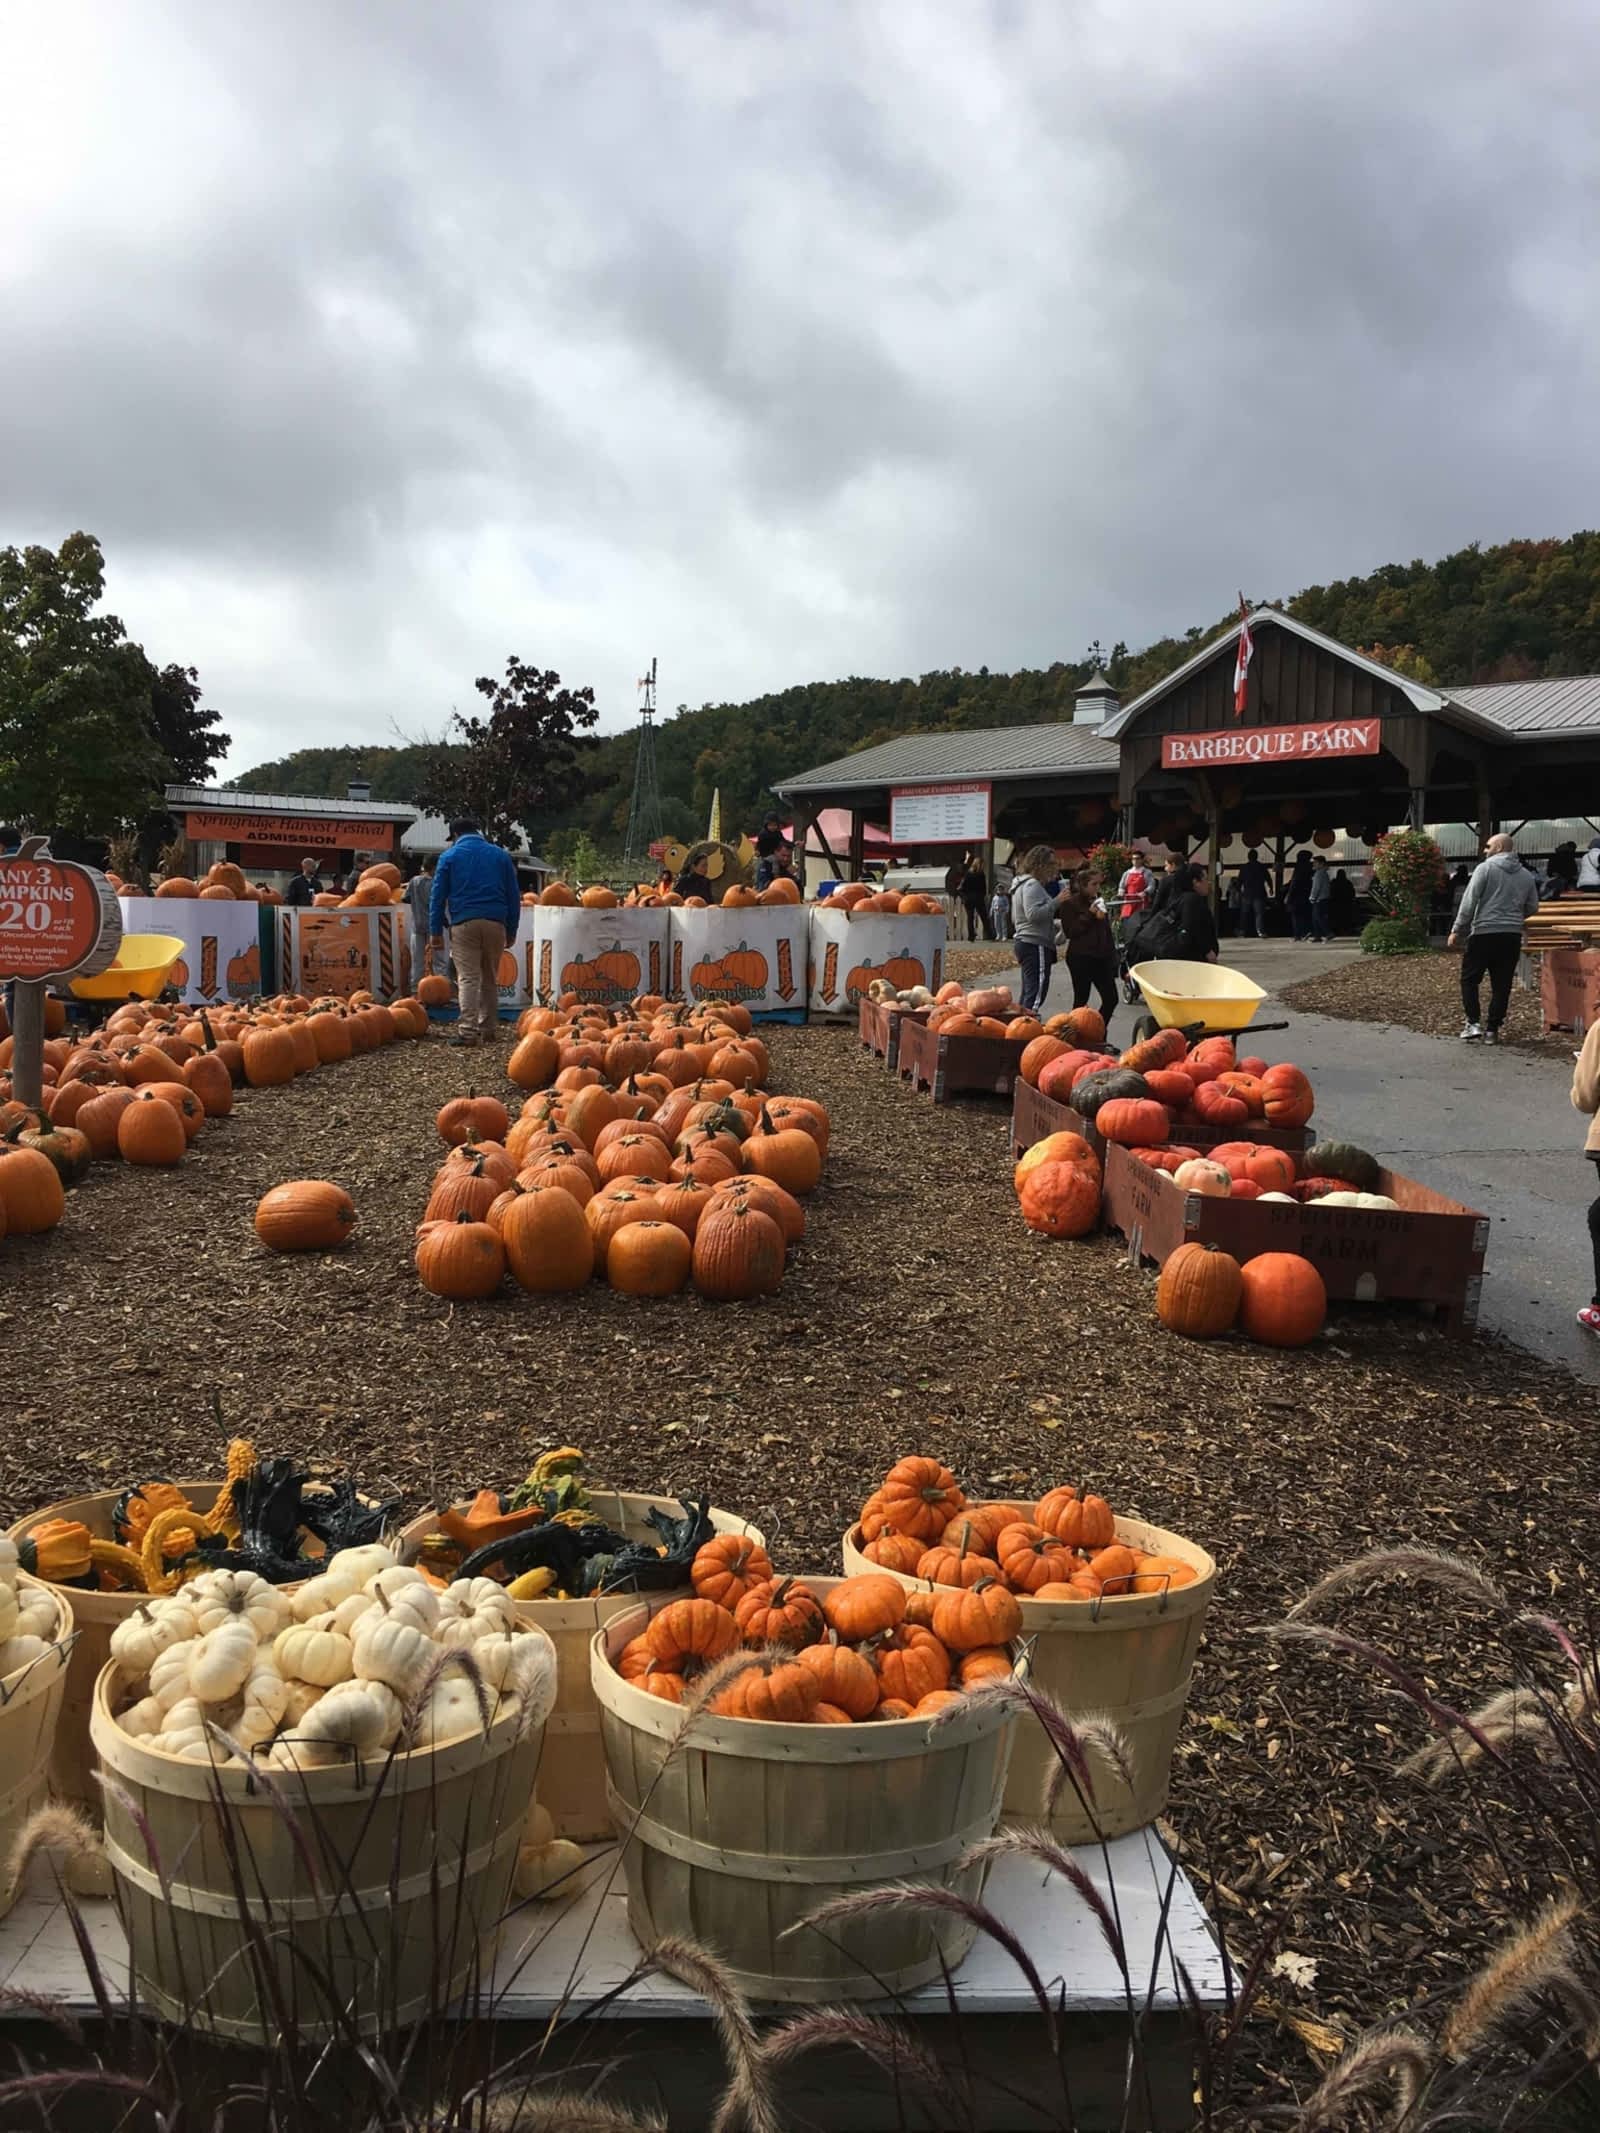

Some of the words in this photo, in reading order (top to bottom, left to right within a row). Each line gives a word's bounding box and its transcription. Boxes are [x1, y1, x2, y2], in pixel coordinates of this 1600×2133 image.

[1170, 733, 1295, 760] BARBEQUE
[1302, 727, 1371, 751] BARN
[247, 832, 337, 845] ADMISSION
[279, 817, 332, 833] Harvest
[335, 821, 386, 836] Festival
[36, 867, 52, 885] 3
[1131, 1185, 1152, 1219] FARM
[1271, 1208, 1416, 1233] SPRINGRIDGE
[1301, 1235, 1378, 1264] FARM
